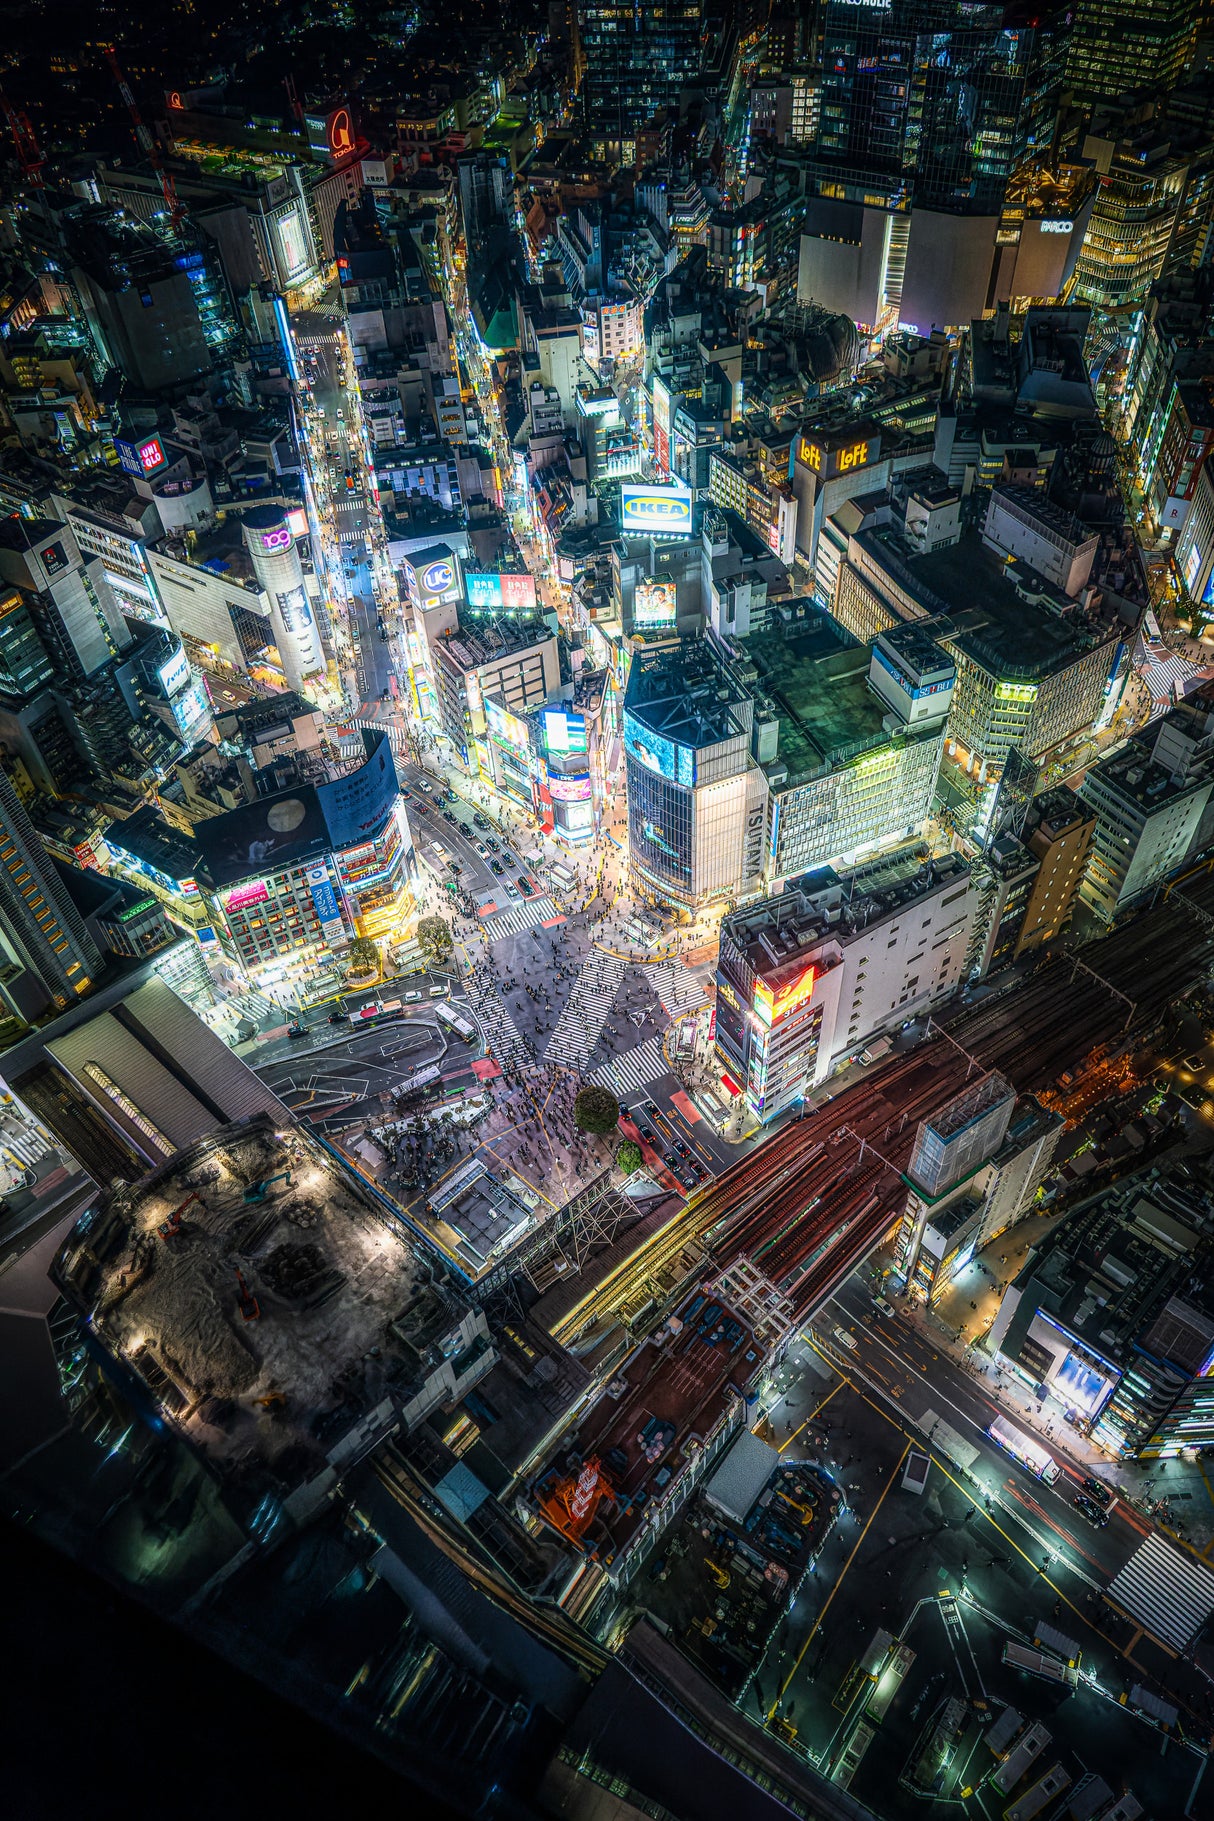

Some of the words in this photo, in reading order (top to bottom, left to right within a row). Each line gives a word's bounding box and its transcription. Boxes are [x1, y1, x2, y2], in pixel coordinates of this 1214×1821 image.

[1041, 221, 1073, 233] PARCO
[120, 443, 135, 459] THE
[141, 443, 158, 458] UNI
[120, 455, 142, 474] PRIME
[145, 453, 161, 467] QLO
[630, 502, 685, 514] IKEA
[263, 530, 290, 549] 109
[919, 681, 950, 698] SEIBU
[744, 803, 764, 880] TSUTAYA
